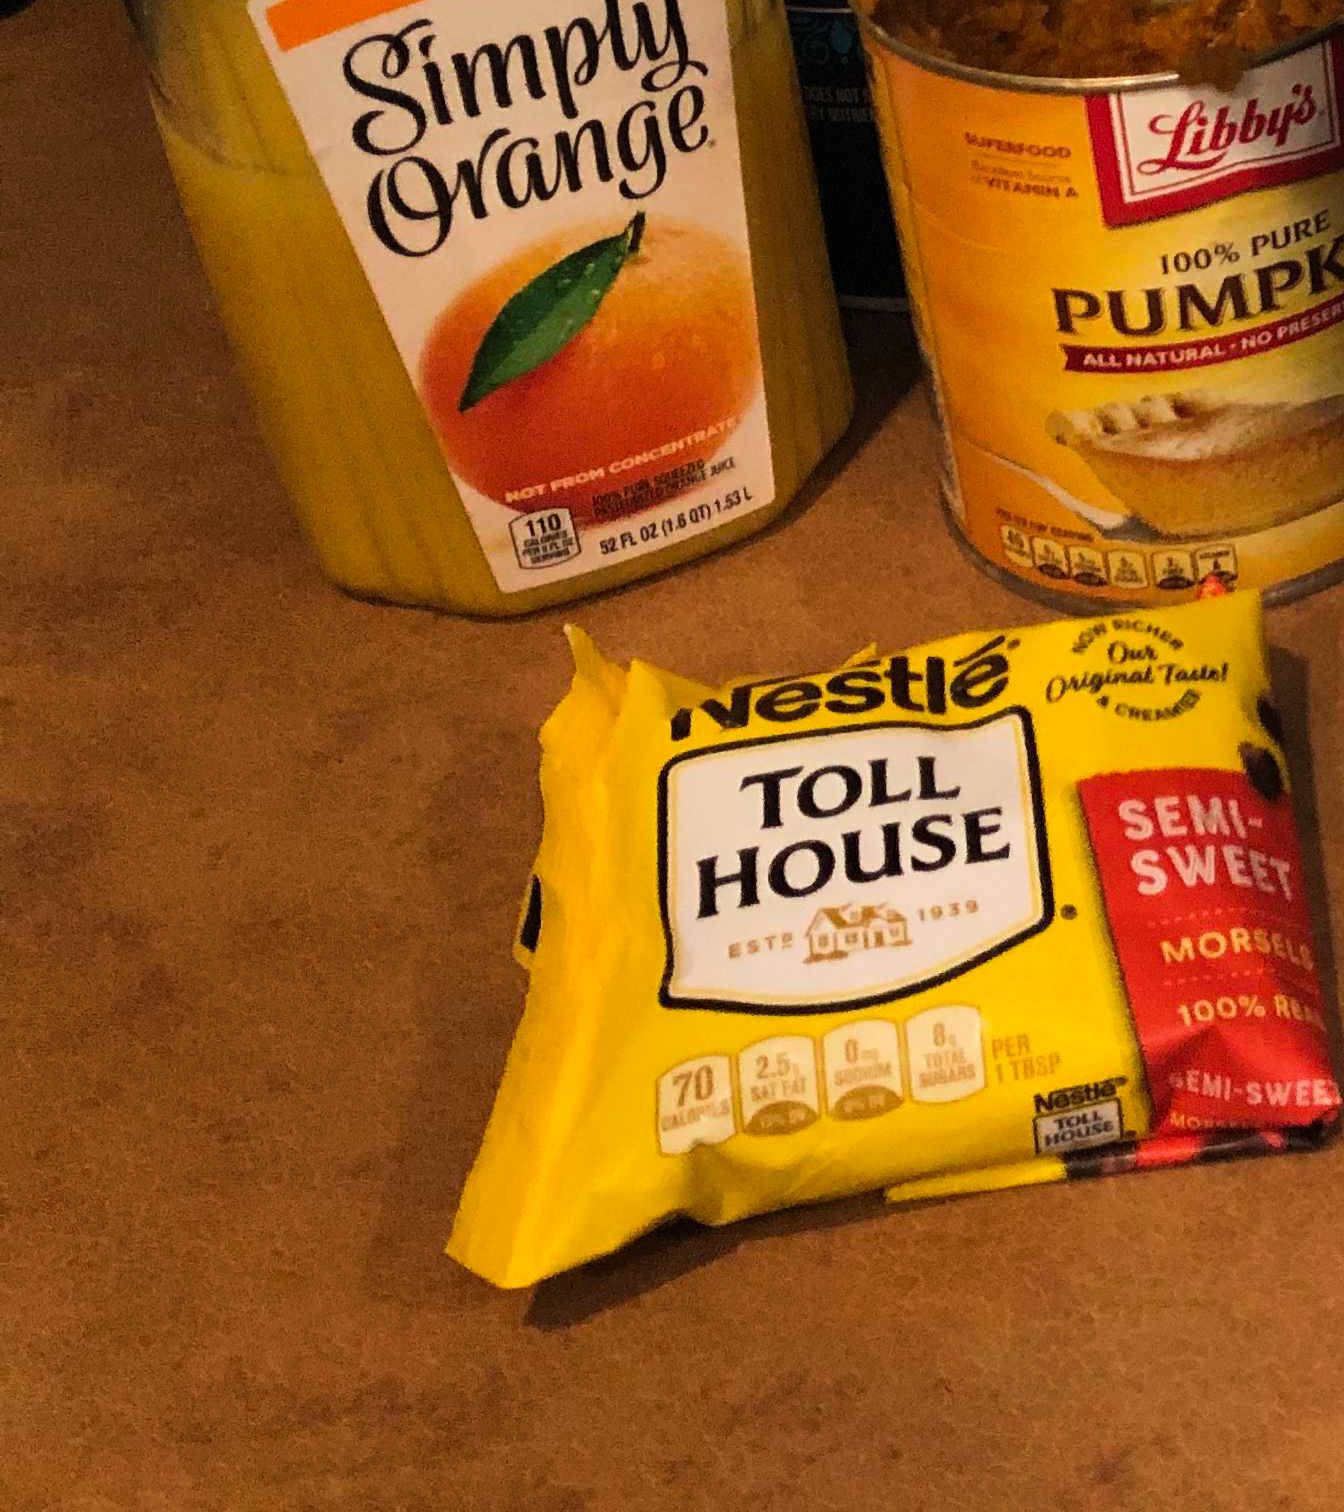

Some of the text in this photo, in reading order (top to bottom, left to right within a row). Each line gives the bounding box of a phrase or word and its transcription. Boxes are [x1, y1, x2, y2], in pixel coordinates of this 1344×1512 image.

[1136, 82, 1317, 176] Libby's
[366, 82, 710, 257] Orange
[1160, 208, 1332, 276] 100% PURE
[1083, 352, 1122, 369] ALL
[1125, 343, 1225, 369] NATURAL
[1240, 330, 1273, 350] NO
[504, 483, 548, 505] NOT
[550, 467, 605, 493] FROM
[608, 417, 743, 475] CONCENTRATE
[526, 512, 562, 538] 110
[599, 485, 754, 556] 52 FL OZ (1.6 QT) 1.53 L
[1106, 640, 1159, 665] Our
[668, 634, 1011, 742] Nestlé
[1045, 661, 1230, 704] Original Taste!
[738, 755, 962, 831] TOLL
[1117, 793, 1264, 841] SEMI-
[695, 806, 1012, 921] HOUSE
[1129, 844, 1293, 902] SWEET
[917, 898, 981, 923] 1939
[1160, 925, 1316, 971] MORSELS
[1176, 994, 1267, 1028] 100%
[990, 1033, 1031, 1060] PER
[995, 1053, 1061, 1084] 1 TBSP
[672, 1064, 715, 1108] 70
[1053, 1109, 1104, 1130] TOLL
